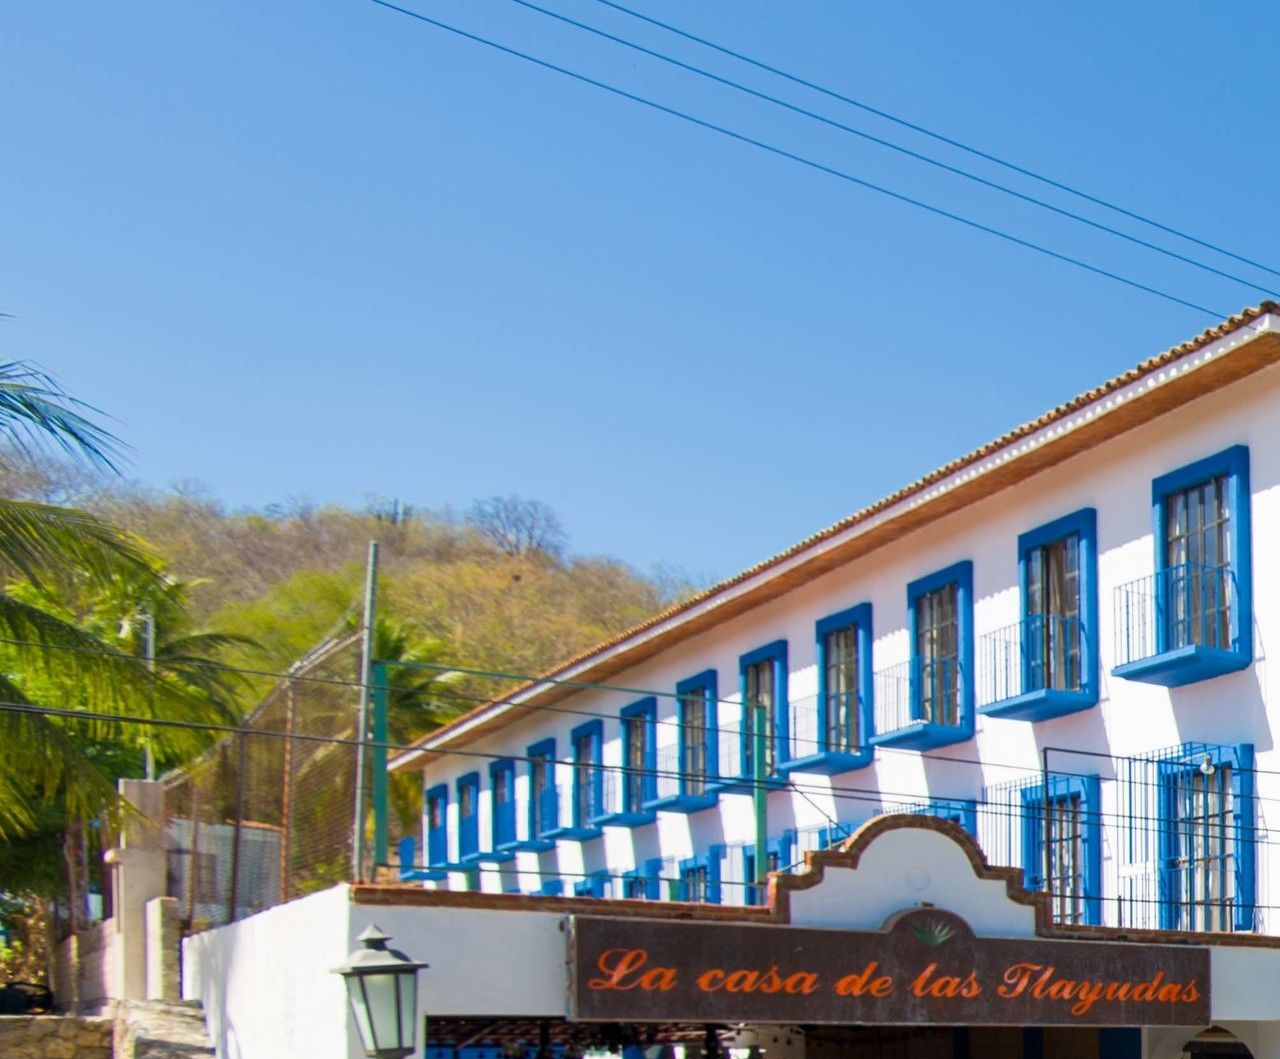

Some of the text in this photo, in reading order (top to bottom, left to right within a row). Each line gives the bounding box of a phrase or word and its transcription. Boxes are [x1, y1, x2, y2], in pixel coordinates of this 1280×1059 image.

[587, 948, 1201, 1016] La casa de las Tlayudas
